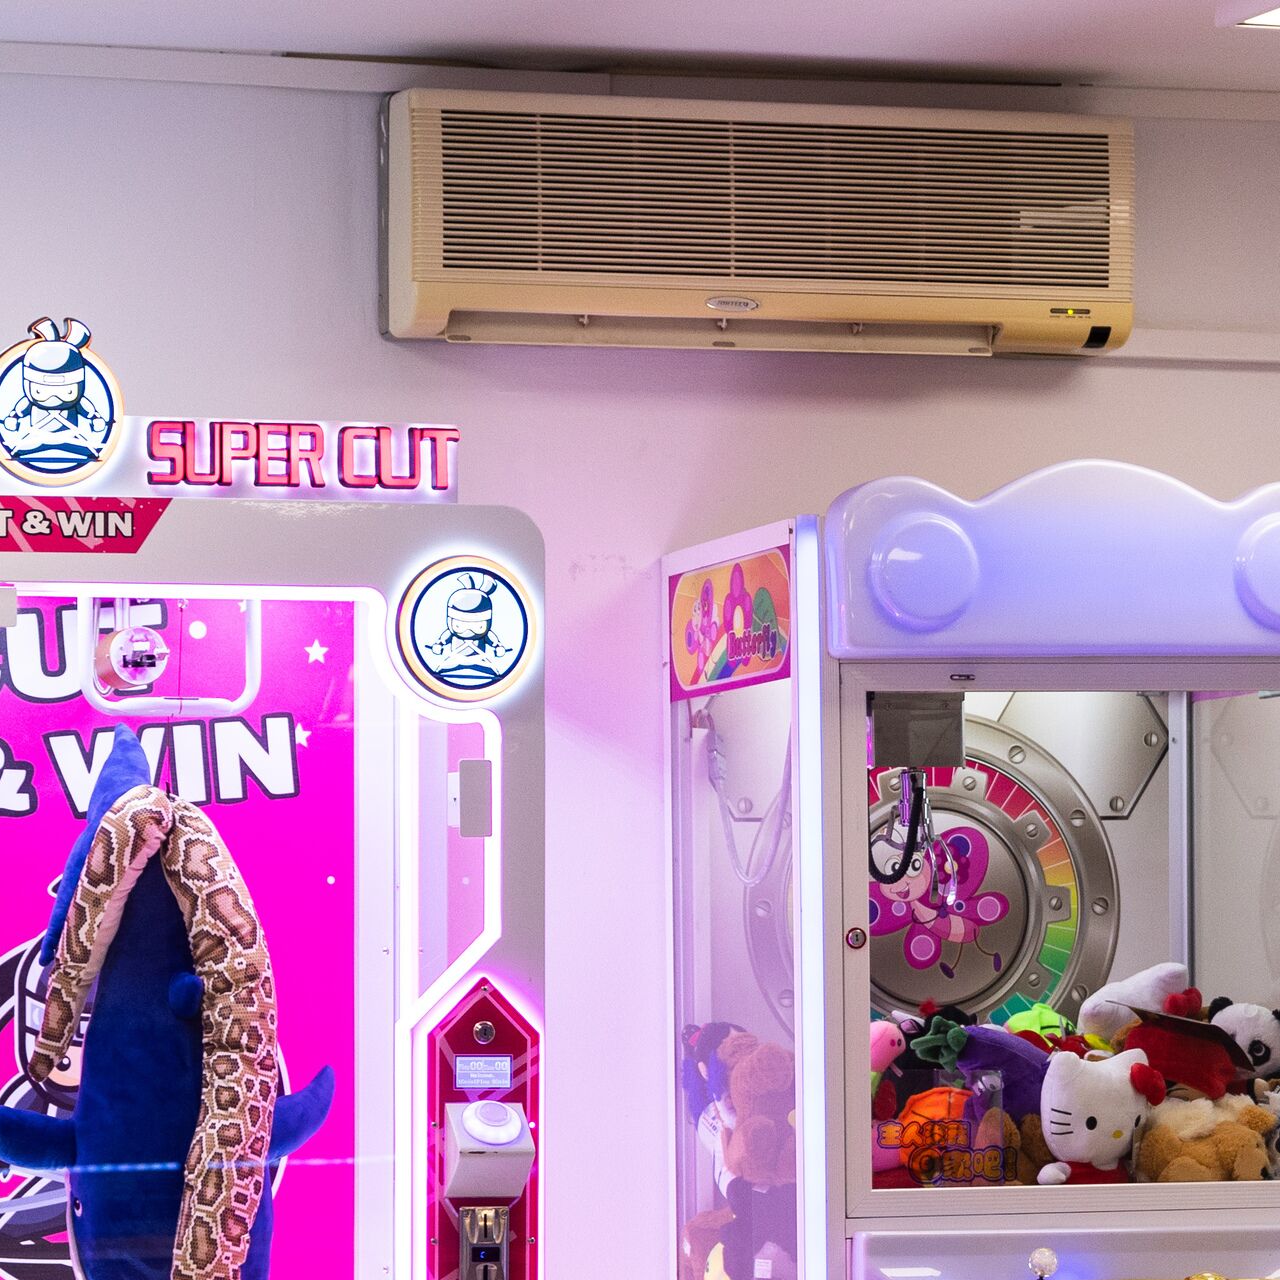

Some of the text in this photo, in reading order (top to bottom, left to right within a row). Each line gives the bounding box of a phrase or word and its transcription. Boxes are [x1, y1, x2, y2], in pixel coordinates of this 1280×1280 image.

[147, 420, 461, 491] SUPER CUT
[21, 509, 52, 536] &
[56, 510, 135, 538] WIN
[728, 623, 778, 660] Butterfly
[42, 711, 301, 820] WIN
